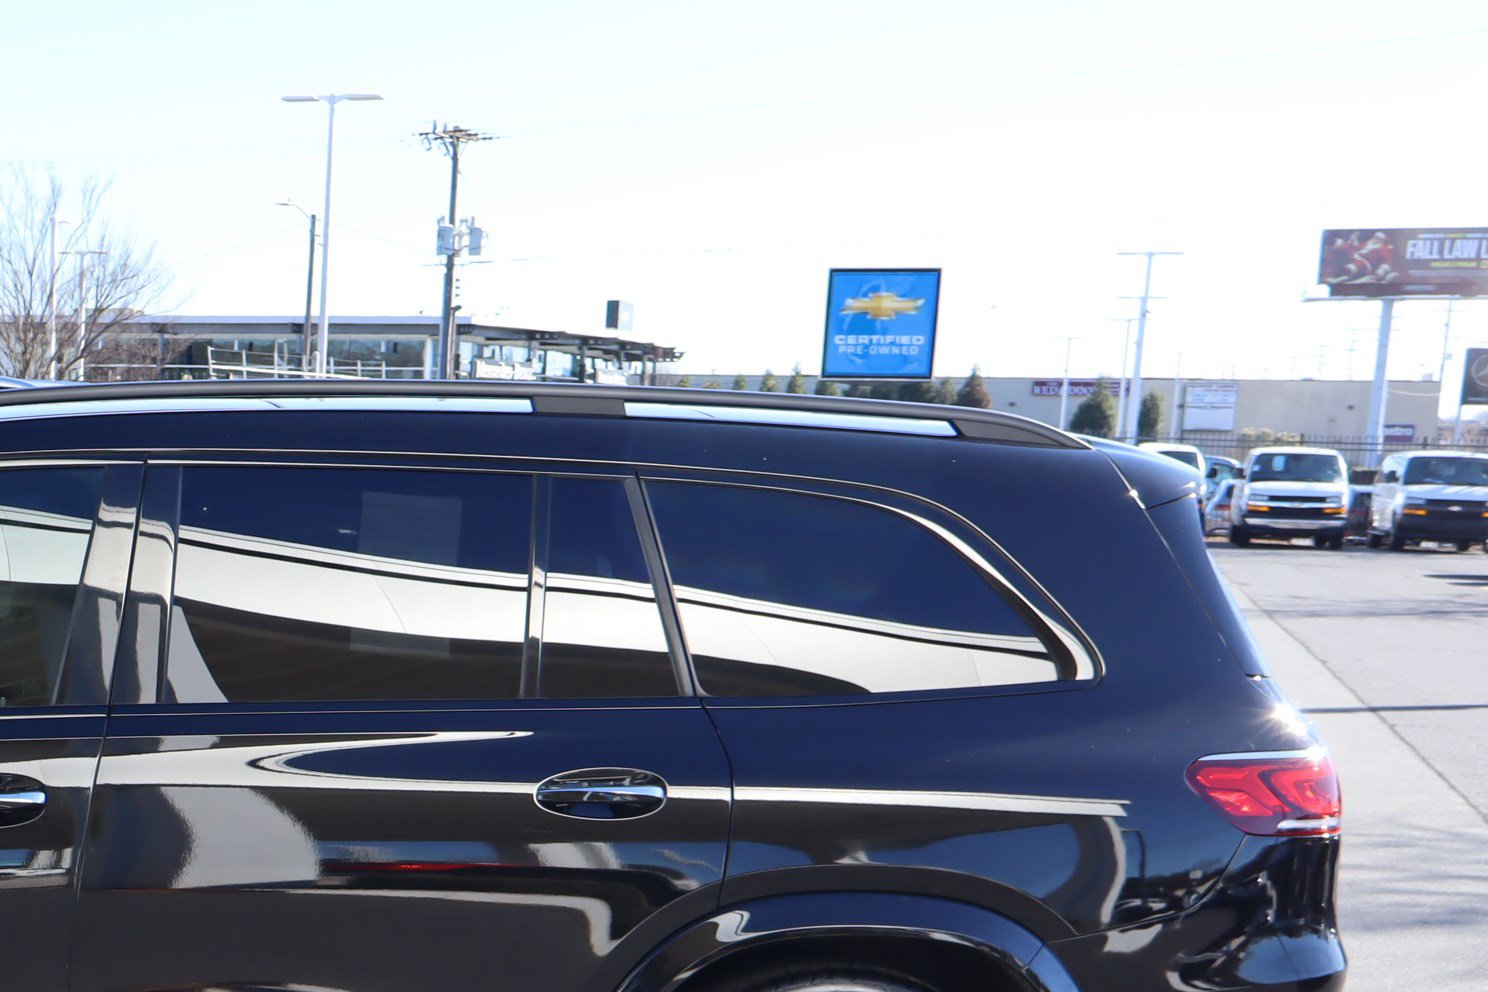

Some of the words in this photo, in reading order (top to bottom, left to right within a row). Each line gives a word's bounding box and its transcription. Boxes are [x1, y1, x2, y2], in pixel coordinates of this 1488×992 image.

[1406, 239, 1440, 259] FALL
[1443, 239, 1480, 259] LAW
[834, 334, 925, 345] CERTIFIED
[838, 345, 918, 355] PRE-OWNED
[1033, 386, 1058, 395] RED
